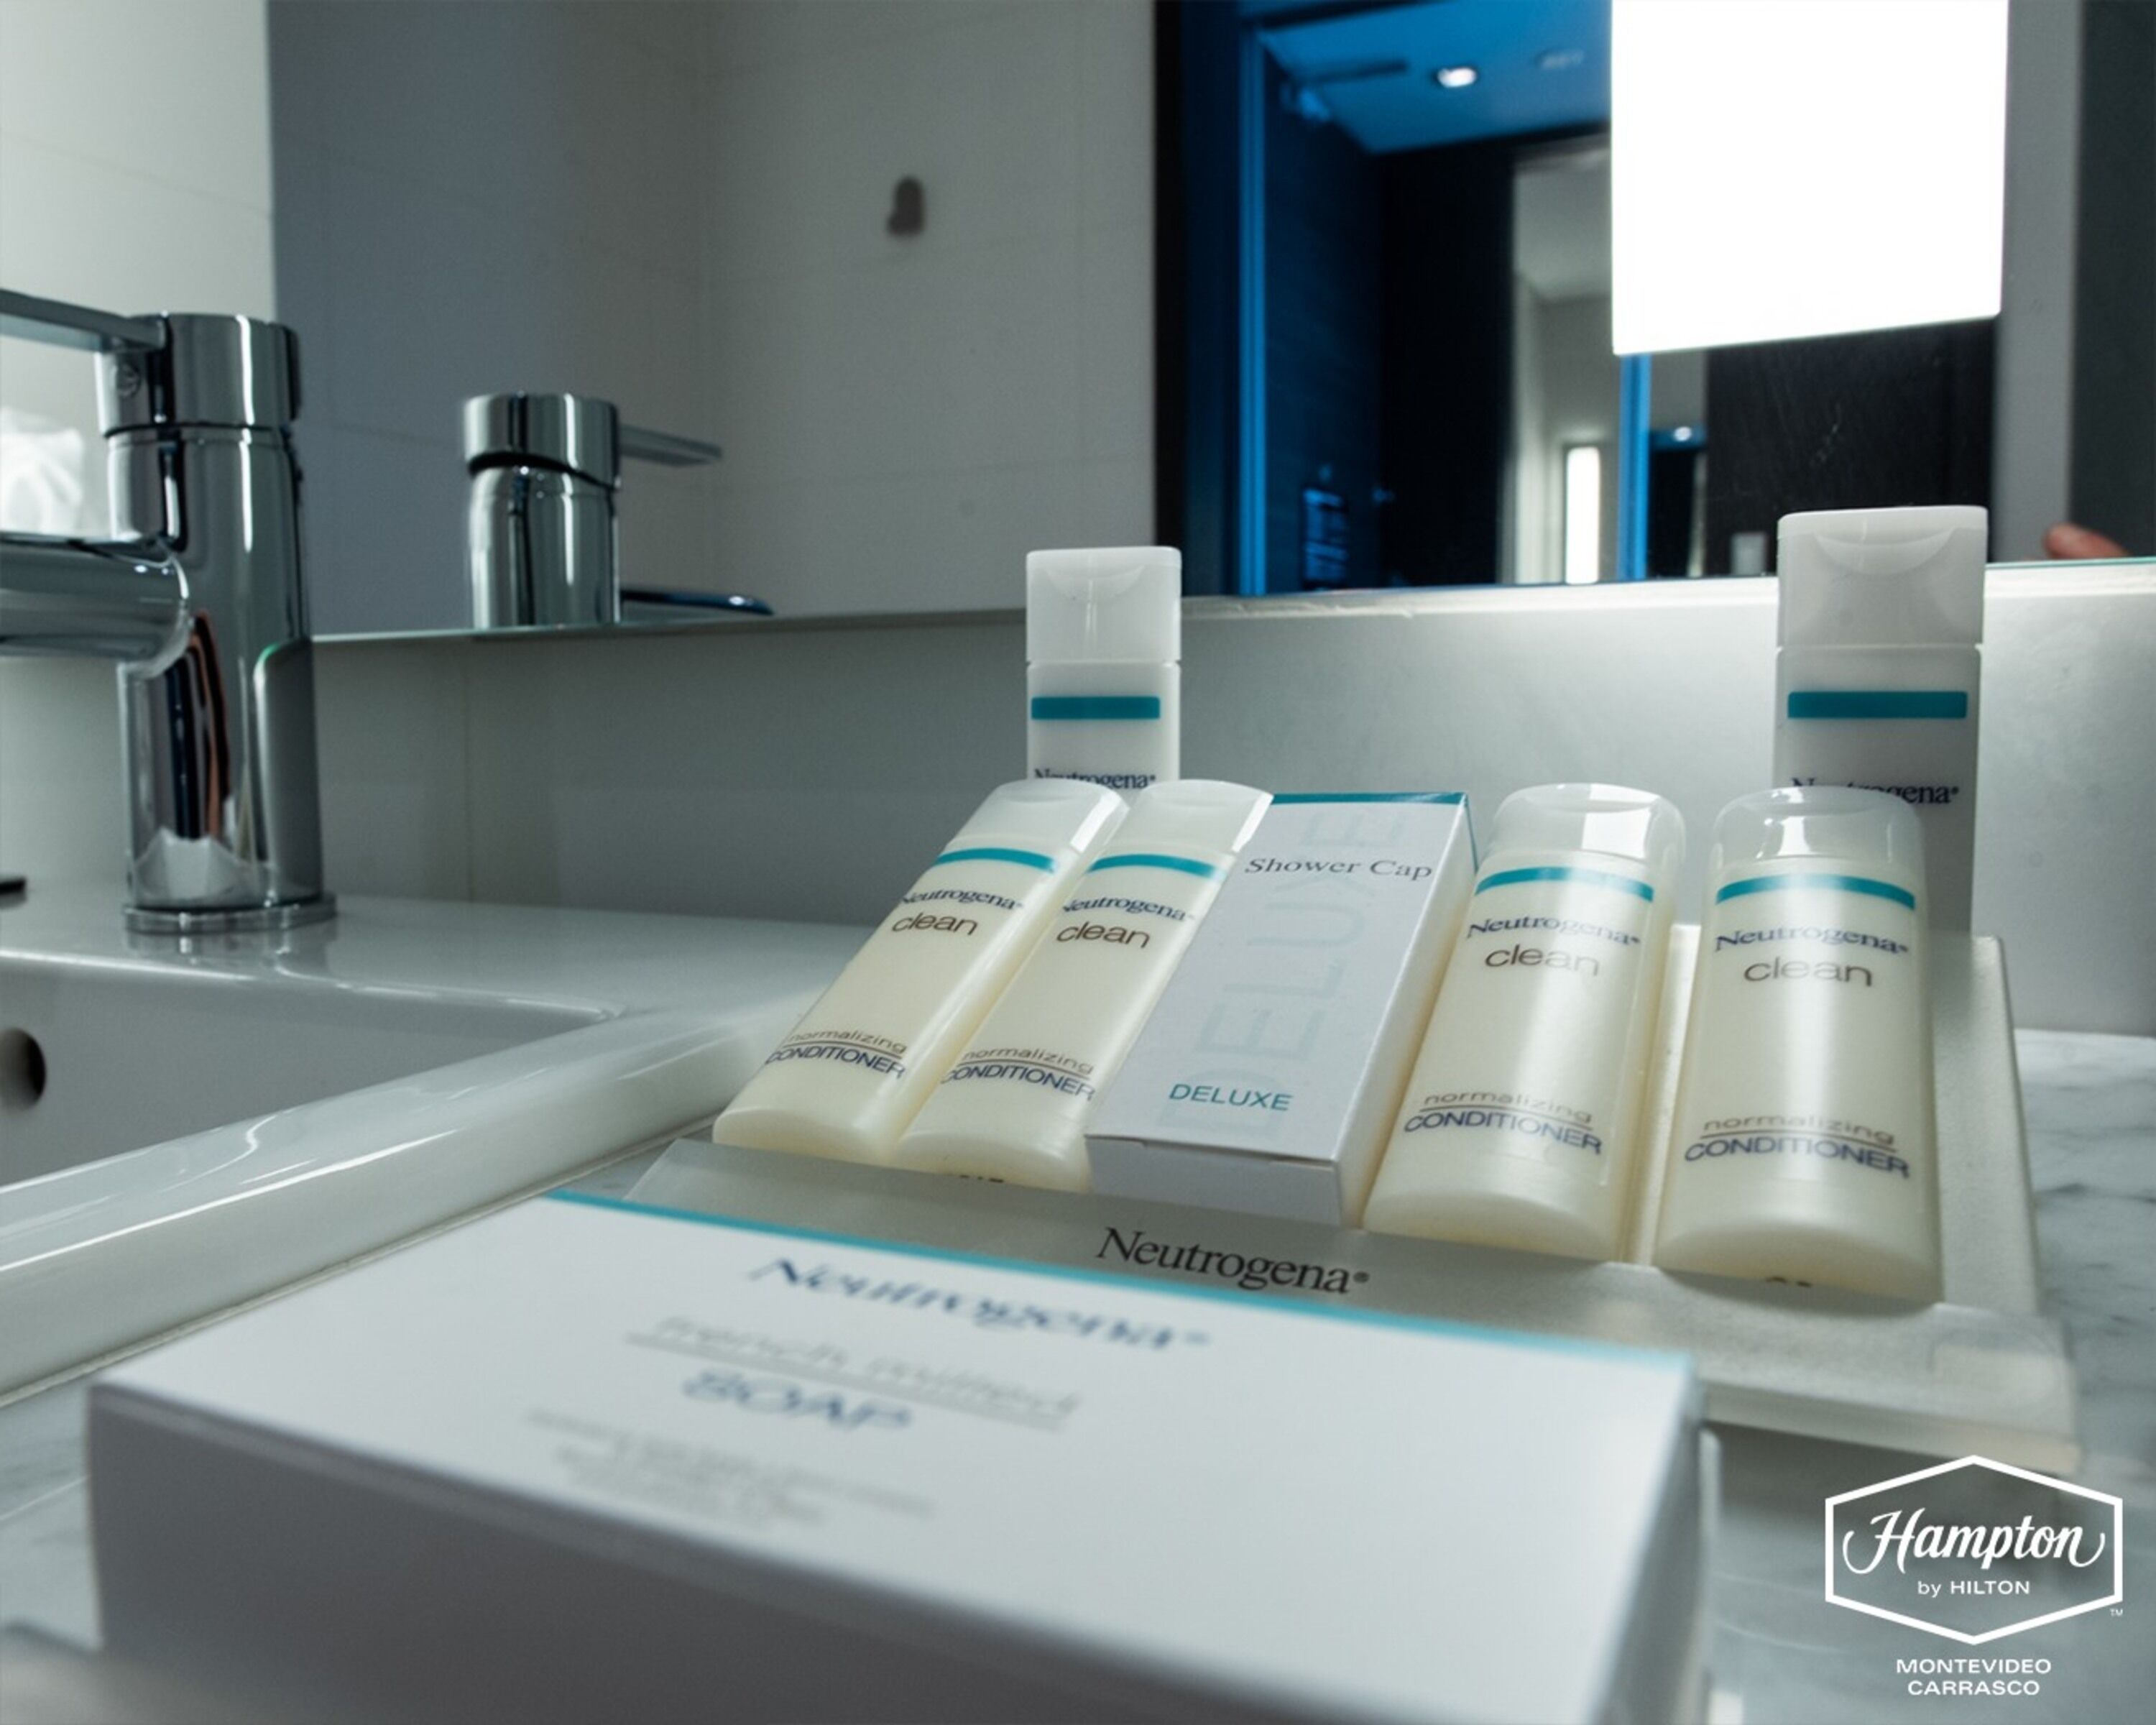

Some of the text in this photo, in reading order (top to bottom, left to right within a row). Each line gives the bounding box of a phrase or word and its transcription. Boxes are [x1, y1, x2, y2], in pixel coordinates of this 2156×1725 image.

[1244, 857, 1432, 881] Shower Cap
[891, 912, 978, 935] clean
[1056, 921, 1150, 948] clean
[1485, 944, 1600, 976] clean
[1743, 957, 1872, 987] clean
[789, 1029, 908, 1054] normalizing
[765, 1045, 906, 1079] CONDITIONER
[963, 1046, 1095, 1075] normalizing
[939, 1064, 1097, 1102] CONDITIONER
[1169, 1084, 1294, 1111] DELUXE
[1424, 1092, 1593, 1124] normalizing
[1404, 1110, 1603, 1155] CONDITIONER
[1703, 1115, 1895, 1145] normalizing
[1685, 1136, 1909, 1179] CONDITIONER
